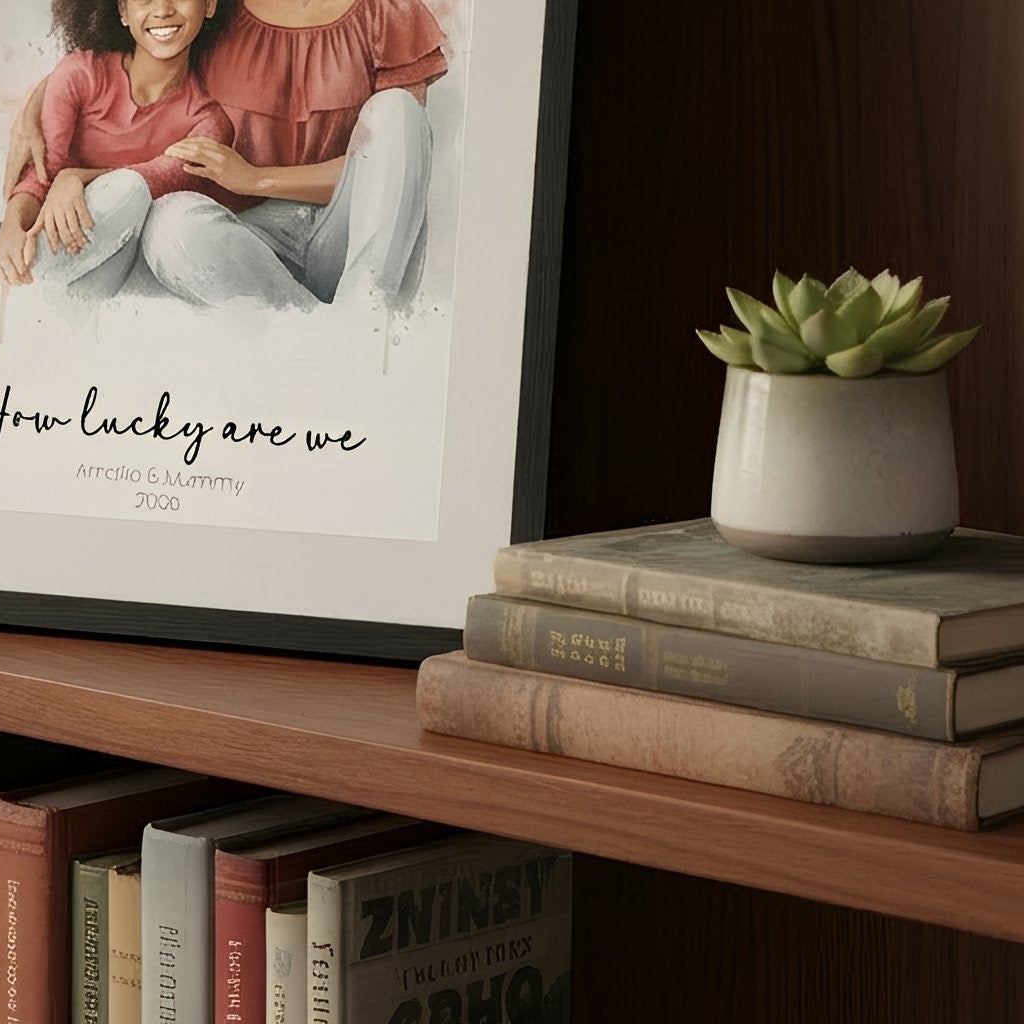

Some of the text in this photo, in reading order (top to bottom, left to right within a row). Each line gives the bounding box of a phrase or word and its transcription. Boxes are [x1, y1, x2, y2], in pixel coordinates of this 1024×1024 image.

[80, 385, 214, 465] lucky
[221, 421, 297, 447] are
[305, 430, 367, 452] we
